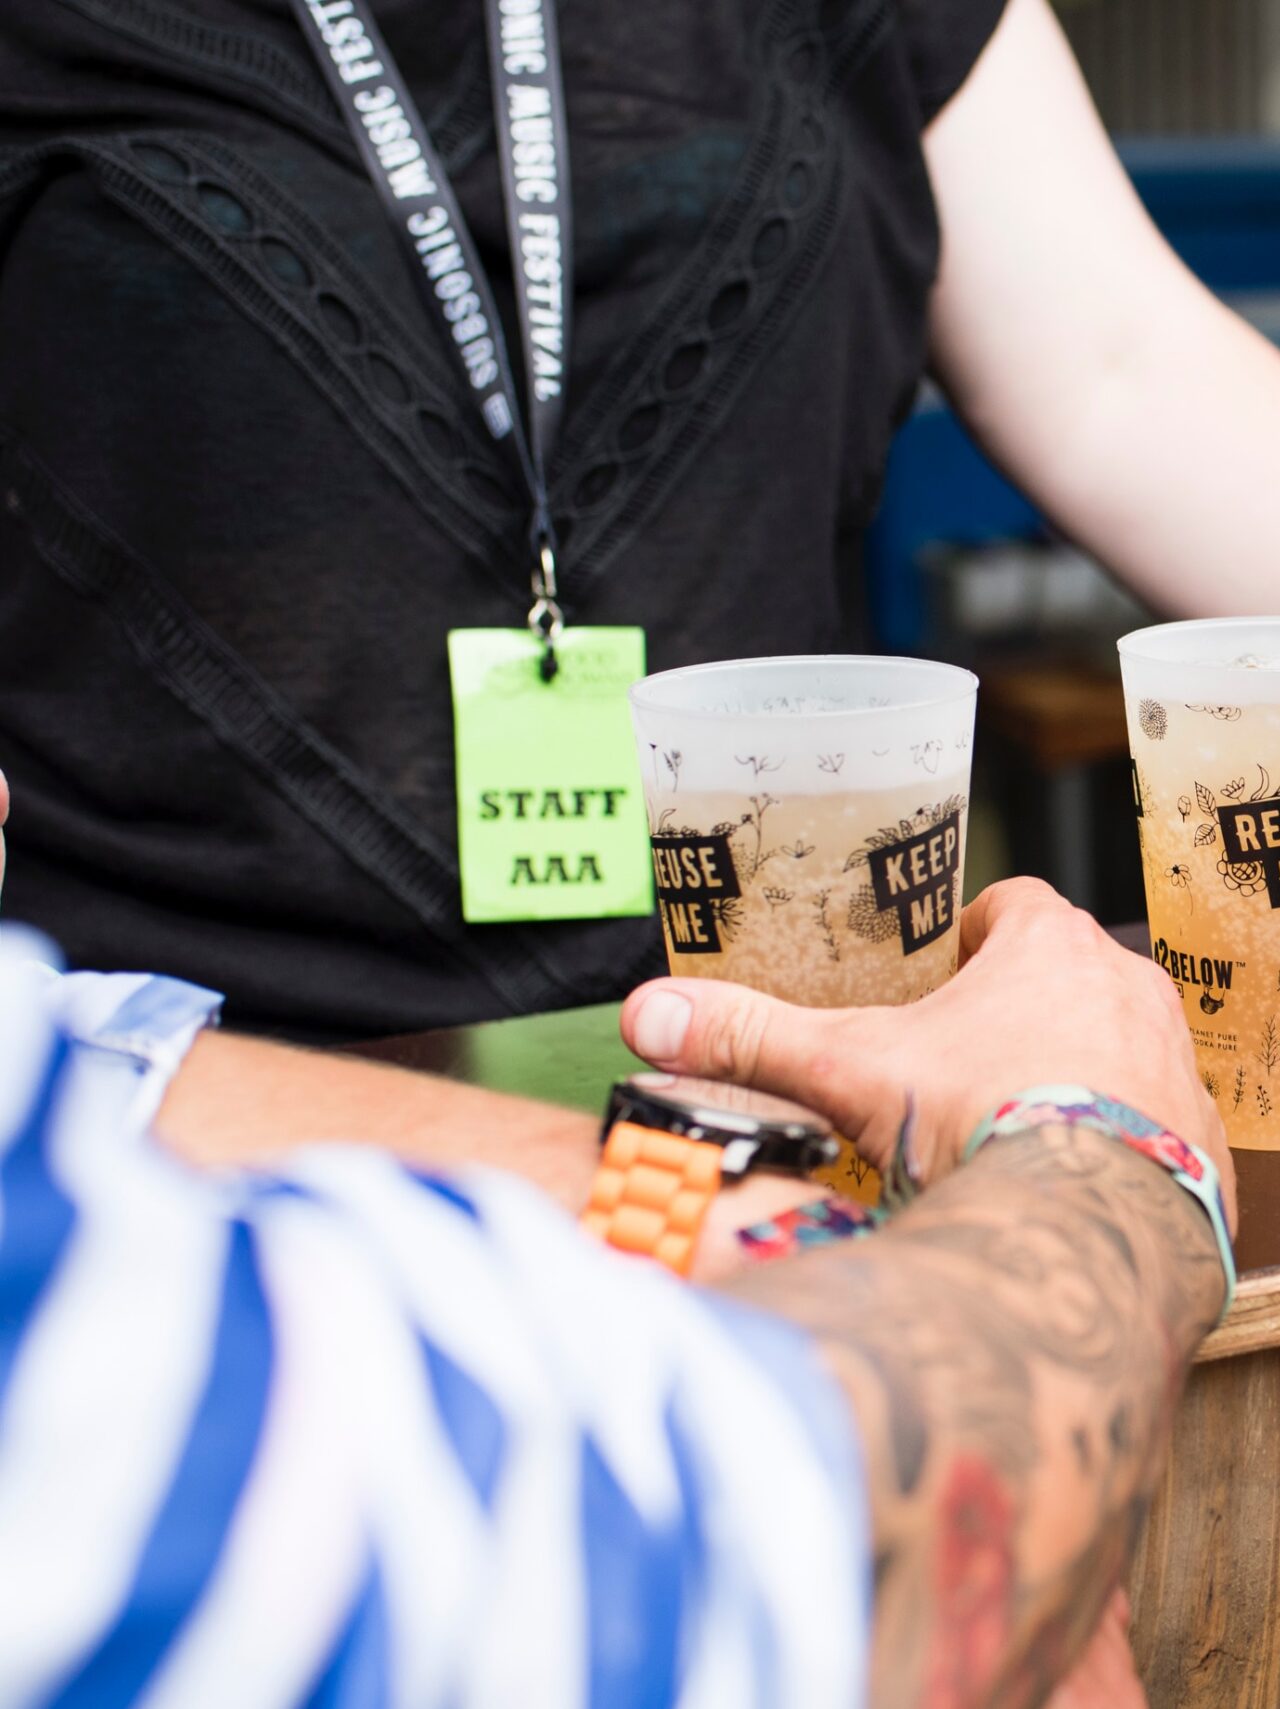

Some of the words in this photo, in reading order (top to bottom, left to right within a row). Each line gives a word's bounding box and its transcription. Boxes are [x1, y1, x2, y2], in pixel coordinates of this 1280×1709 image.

[353, 85, 438, 199] MUSIC
[506, 84, 559, 203] MUSIC
[407, 205, 499, 390] SUBSONIC
[518, 213, 563, 401] FESTIVAL
[480, 787, 627, 821] STAFF
[510, 855, 604, 886] AAA
[886, 826, 956, 896] KEEP
[669, 903, 709, 943] ME
[911, 883, 948, 940] ME
[1193, 1038, 1214, 1049] ODKA
[1217, 1043, 1237, 1052] PURE
[1217, 1033, 1238, 1042] PURE
